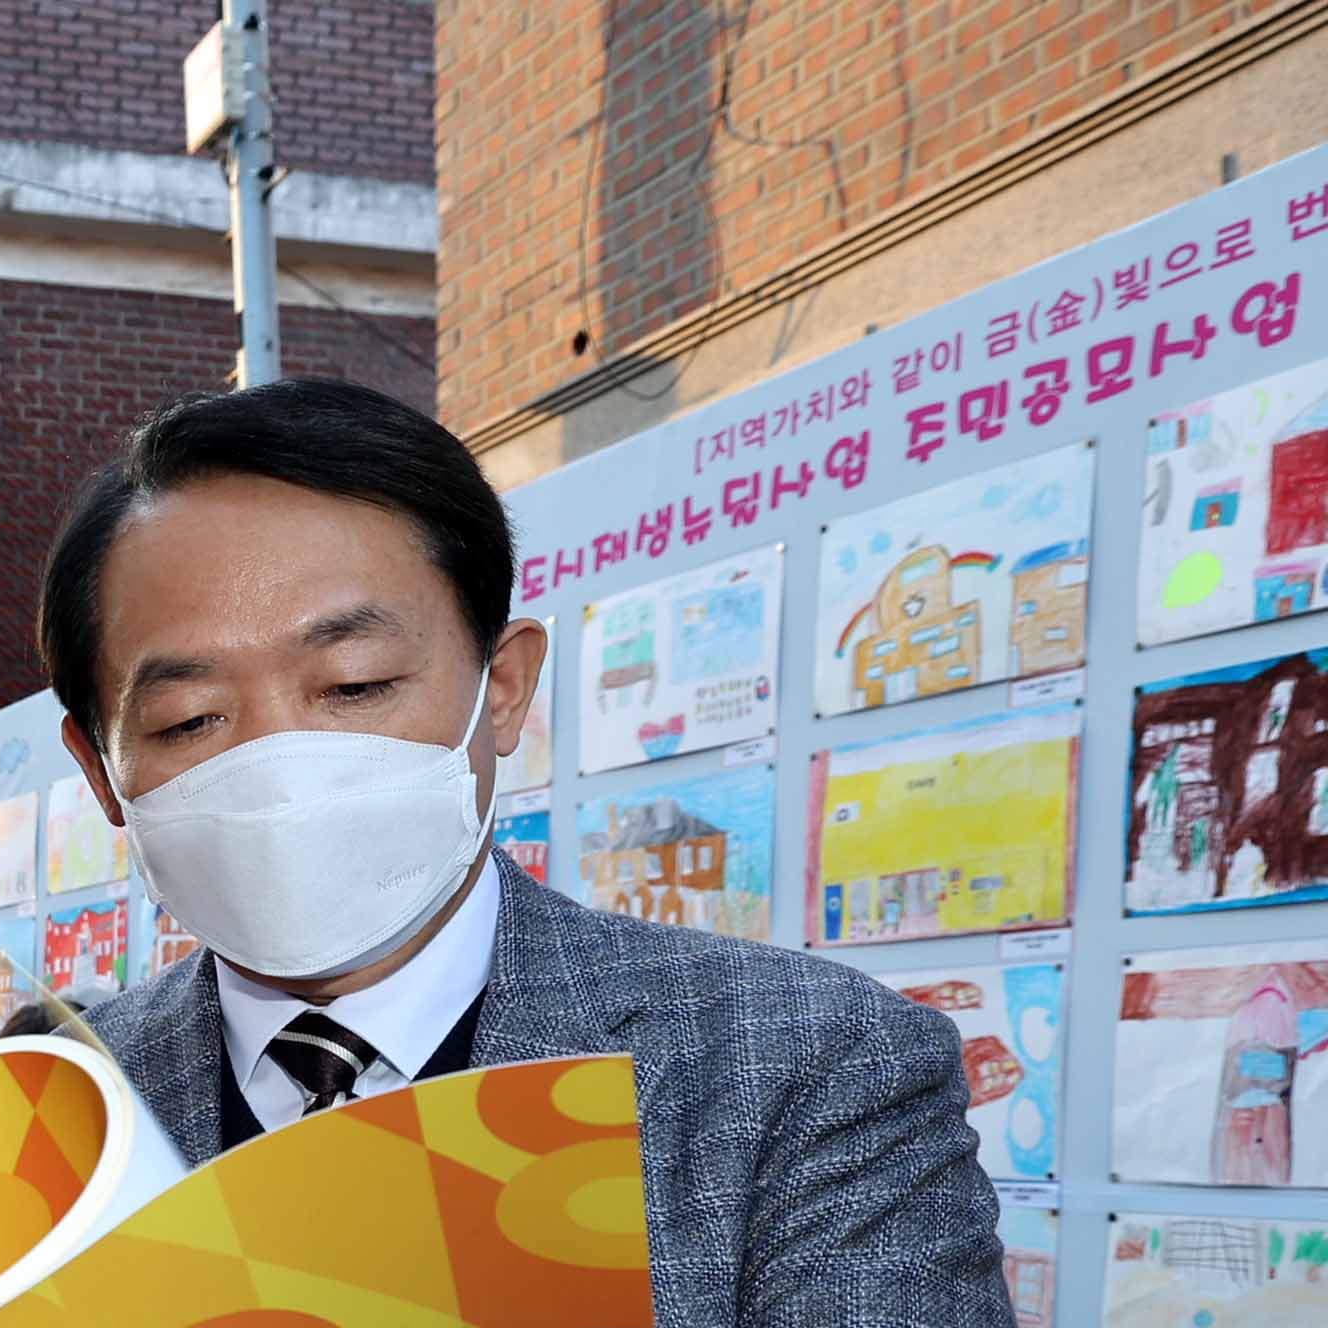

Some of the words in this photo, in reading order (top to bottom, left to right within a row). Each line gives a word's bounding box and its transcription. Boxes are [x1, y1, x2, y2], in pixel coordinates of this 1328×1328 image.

[693, 368, 872, 475] [지역가치와
[890, 333, 963, 397] 같이
[985, 217, 1258, 359] 금(金)빛으로
[904, 270, 1304, 464] 주민공모사업
